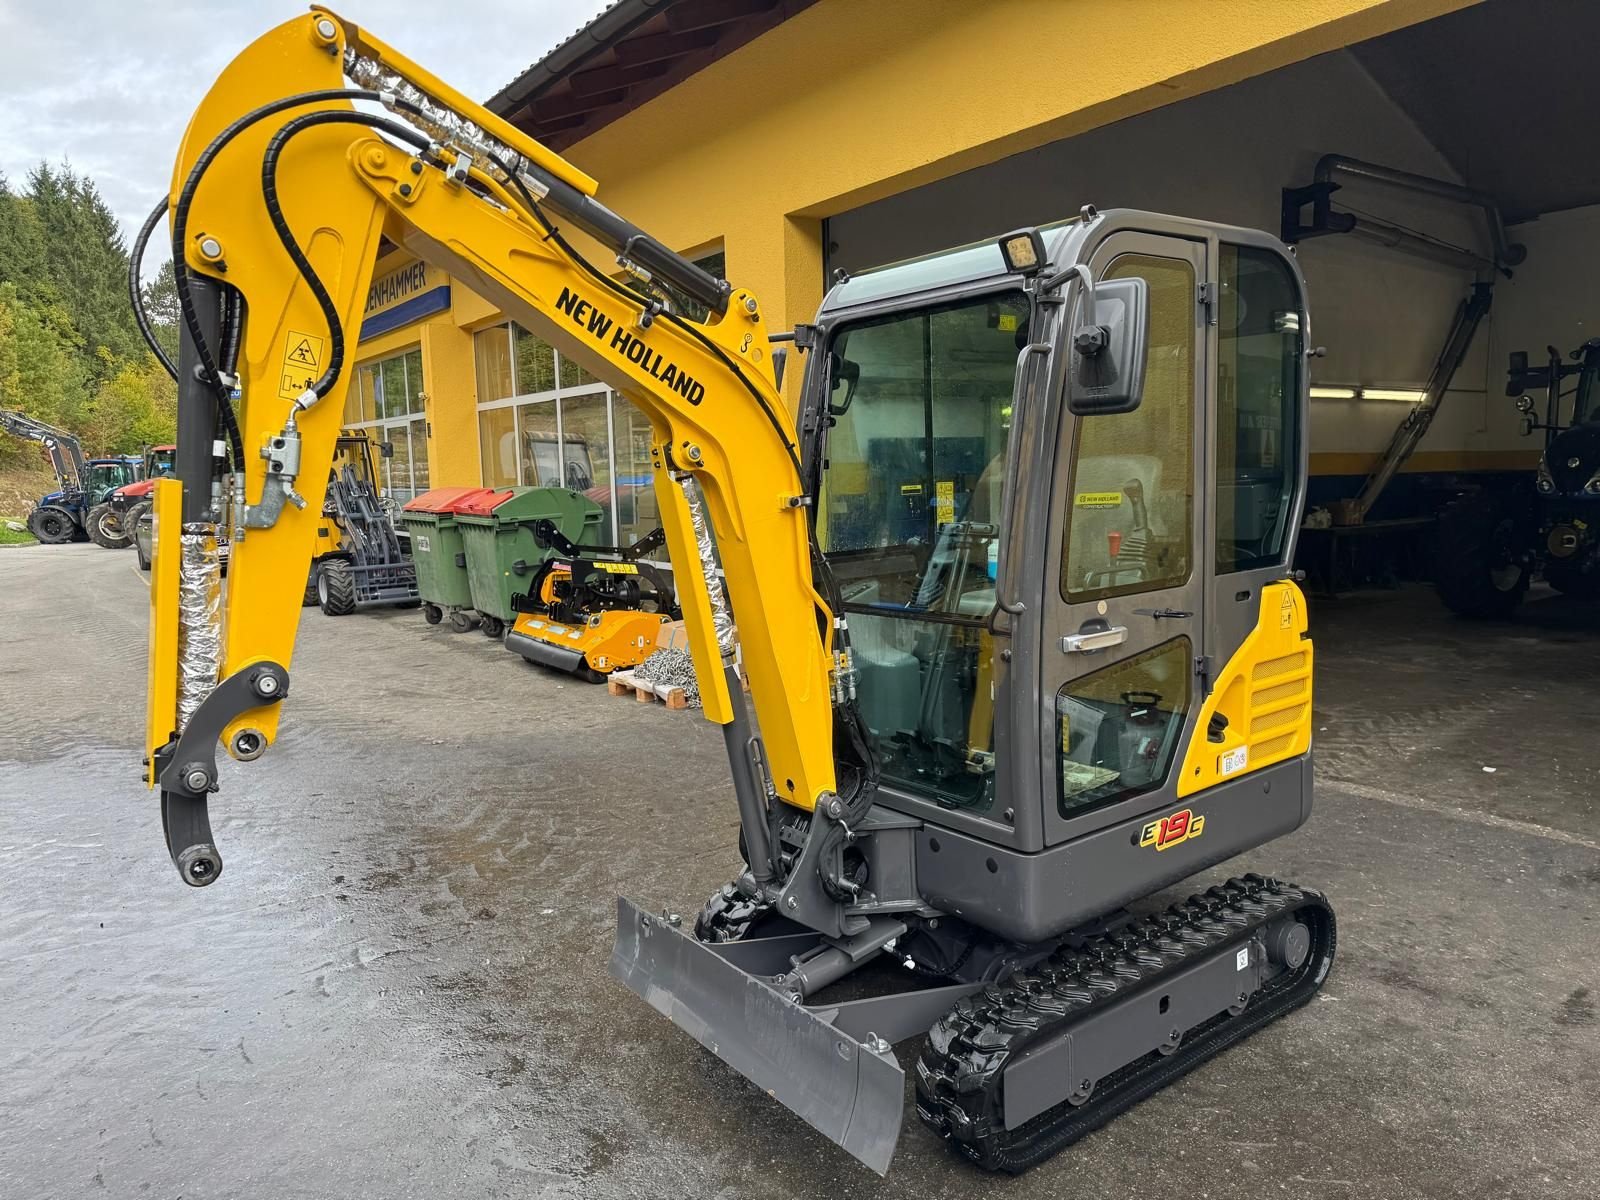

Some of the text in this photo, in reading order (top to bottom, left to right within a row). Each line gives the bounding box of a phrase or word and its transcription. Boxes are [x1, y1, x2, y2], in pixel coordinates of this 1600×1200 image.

[555, 286, 705, 406] NEW HOLLAND
[1141, 810, 1203, 848] E19C
